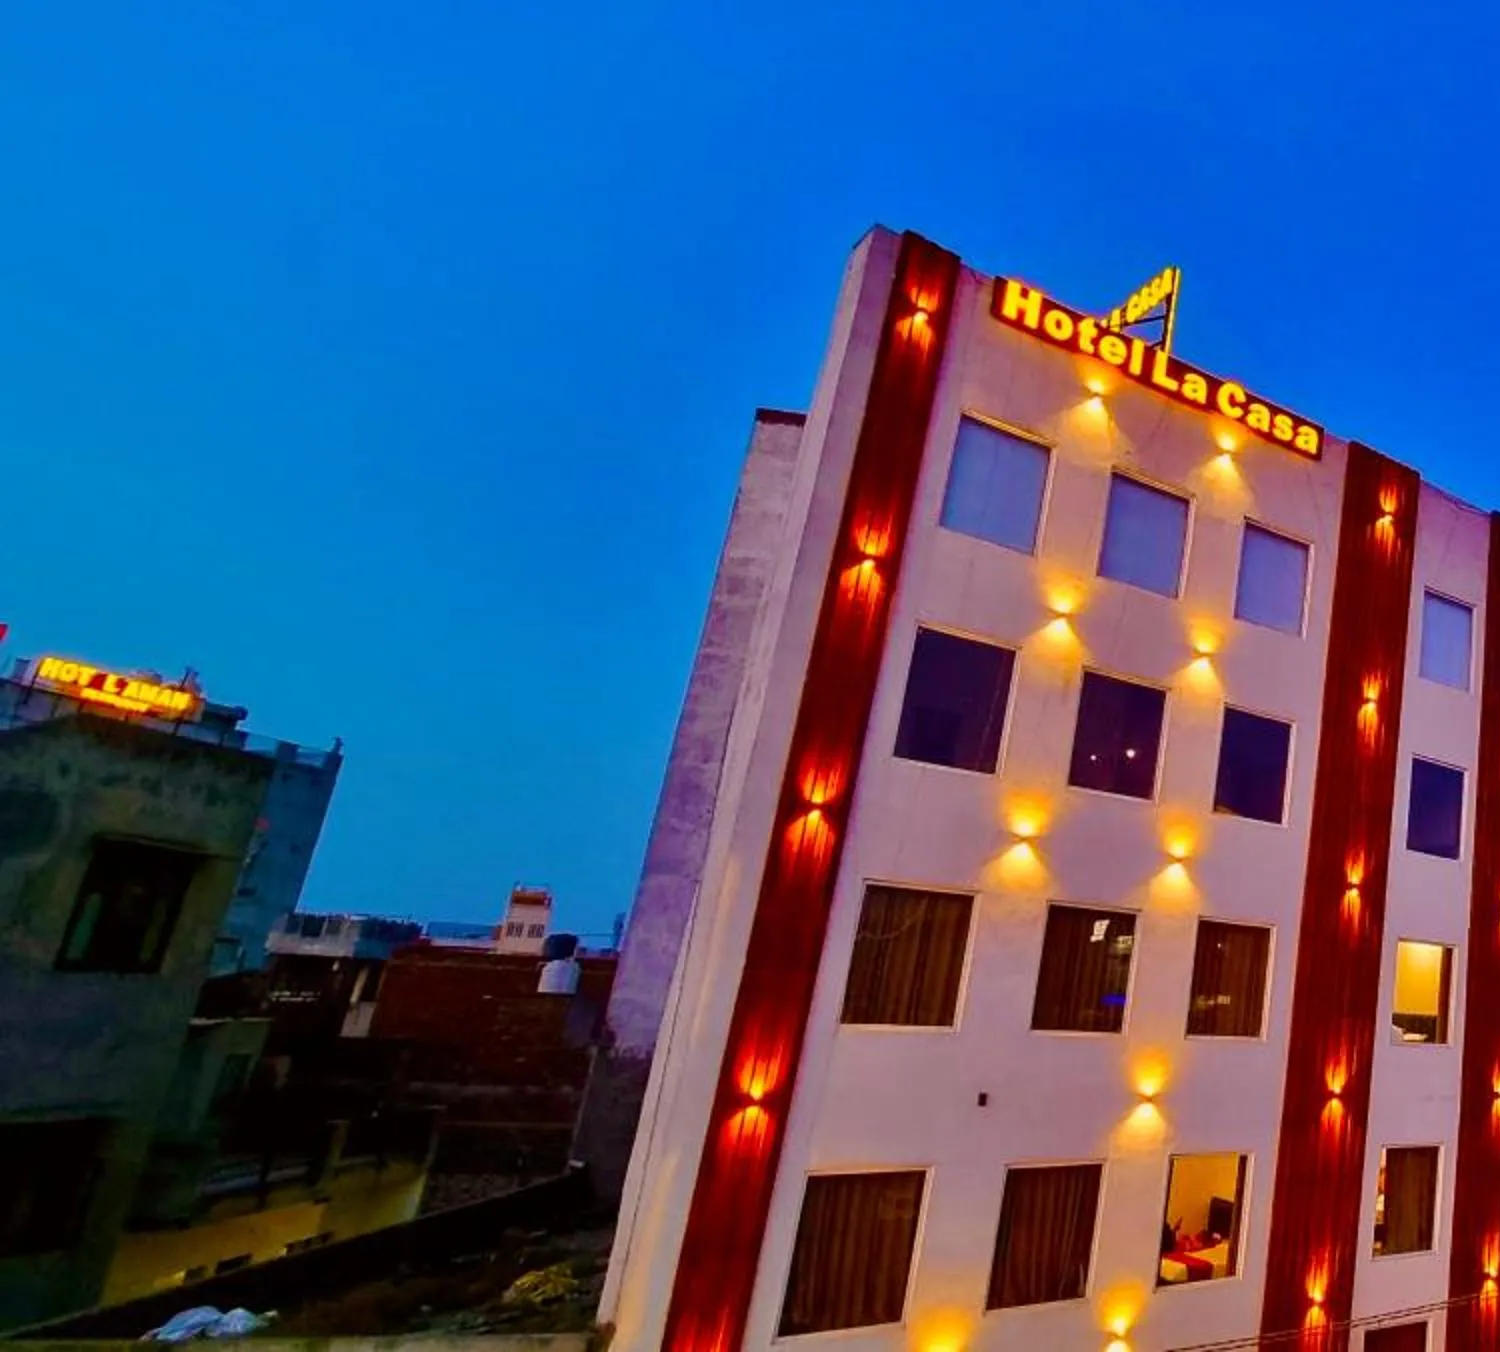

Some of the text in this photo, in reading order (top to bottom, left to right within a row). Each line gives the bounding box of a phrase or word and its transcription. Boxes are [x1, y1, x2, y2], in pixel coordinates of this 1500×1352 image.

[1125, 266, 1174, 323] CASA
[1001, 278, 1320, 455] Hotel La Casa
